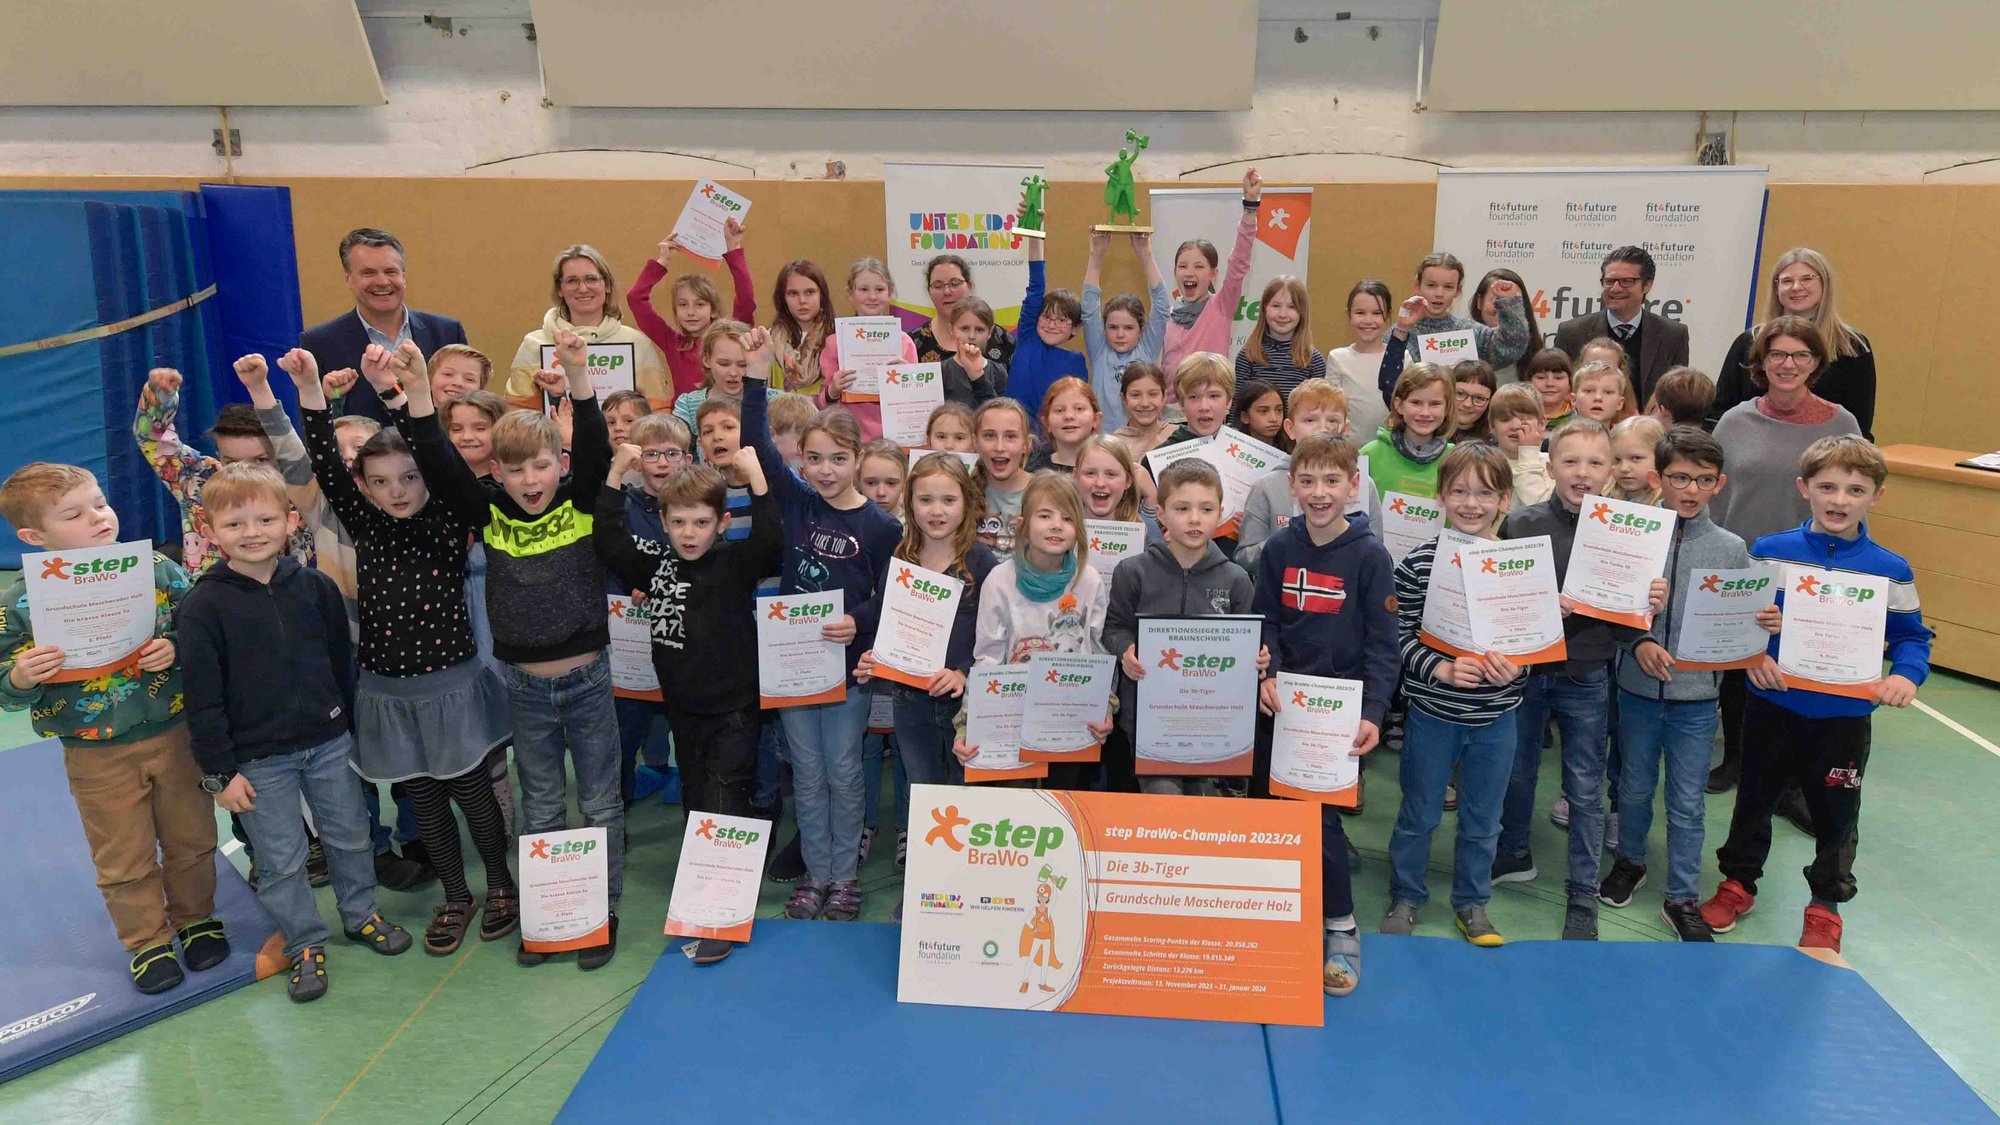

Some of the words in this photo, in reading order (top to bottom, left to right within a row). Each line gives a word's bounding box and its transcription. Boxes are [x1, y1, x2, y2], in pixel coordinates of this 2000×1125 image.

[713, 193, 742, 211] step
[1489, 202, 1539, 212] fit4future
[1566, 202, 1617, 213] fit4future
[1646, 202, 1700, 213] fit4future
[910, 213, 970, 231] UNITED
[974, 213, 1015, 231] KIDS
[1488, 212, 1538, 221] foundation
[1565, 212, 1617, 222] foundation
[1645, 212, 1700, 222] foundation
[911, 232, 1022, 250] FOUNDATIONS
[1486, 239, 1535, 250] fit4future
[1562, 240, 1613, 251] fit4future
[1642, 241, 1695, 252] fit4future
[1485, 249, 1535, 259] foundation
[1650, 252, 1694, 261] undation
[1234, 296, 1262, 321] te
[867, 330, 890, 340] step
[1439, 338, 1468, 349] step
[588, 352, 624, 370] tep
[1238, 451, 1266, 469] step
[1405, 506, 1440, 521] step
[1612, 513, 1662, 534] step
[1609, 523, 1641, 537] BraWo
[814, 533, 831, 551] LIKE
[831, 537, 847, 555] YOU
[1101, 541, 1128, 553] step
[73, 555, 138, 576] step
[1498, 558, 1534, 571] step
[74, 572, 118, 584] BraWo
[1498, 570, 1524, 578] BraWo
[912, 578, 952, 601] step
[1722, 577, 1770, 592] step
[910, 589, 935, 603] BraWo
[1720, 590, 1752, 598] BraWo
[45, 603, 87, 612] Grundschule
[626, 606, 651, 619] ste
[789, 603, 834, 618] step
[789, 616, 819, 625] BraWo
[1182, 653, 1236, 672] step
[1060, 672, 1092, 685] step
[1182, 669, 1217, 677] BraWo
[1001, 682, 1028, 694] ste
[1307, 696, 1343, 711] step
[716, 827, 760, 845] step
[968, 818, 1064, 857] step
[1105, 827, 1133, 840] step
[1136, 827, 1246, 845] BraWo-Champion
[1249, 832, 1302, 846] 2023/24
[551, 839, 597, 855] step
[713, 838, 742, 849] BraWo
[551, 853, 581, 864] BraWo
[968, 848, 1029, 867] BraWo
[1106, 860, 1129, 873] Die
[1132, 861, 1190, 879] 3b-Tiger
[1106, 891, 1181, 906] Grundschule
[1184, 895, 1264, 911] Mascheroder
[1267, 900, 1293, 913] Holz
[919, 940, 960, 952] fit4future
[1103, 934, 1141, 943] Gesammelte
[1143, 936, 1189, 946] Scoring-Punkte
[918, 950, 960, 961] foundation
[1103, 948, 1141, 957] Gesammelte
[1143, 950, 1167, 958] Schritte
[1103, 962, 1146, 973] Zurückgelegte
[1194, 967, 1204, 975] km
[1165, 981, 1197, 989] November
[1228, 984, 1250, 993] Januar
